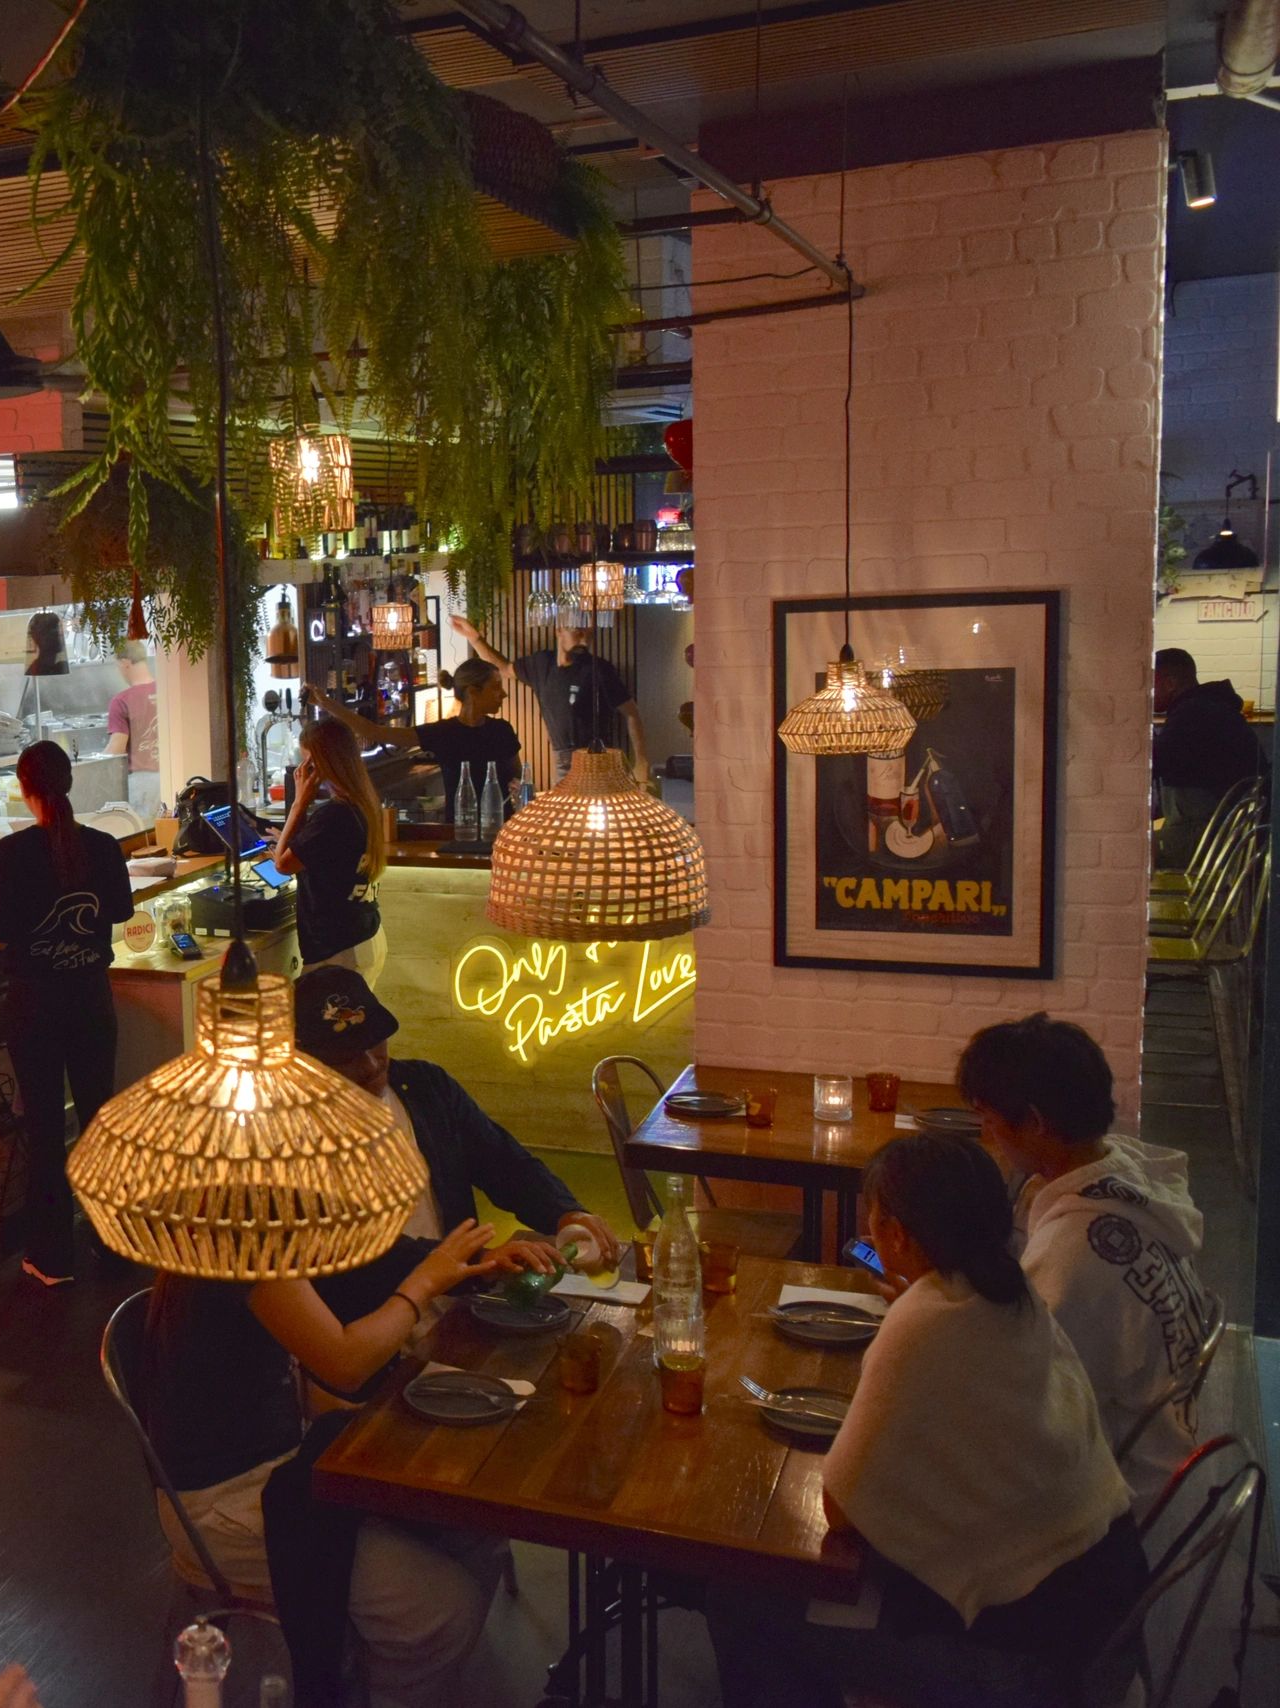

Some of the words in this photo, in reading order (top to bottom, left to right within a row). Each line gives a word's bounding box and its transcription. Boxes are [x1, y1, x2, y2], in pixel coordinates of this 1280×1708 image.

[126, 923, 153, 937] RADICI
[455, 942, 567, 1015] Only
[505, 980, 626, 1062] Pasta
